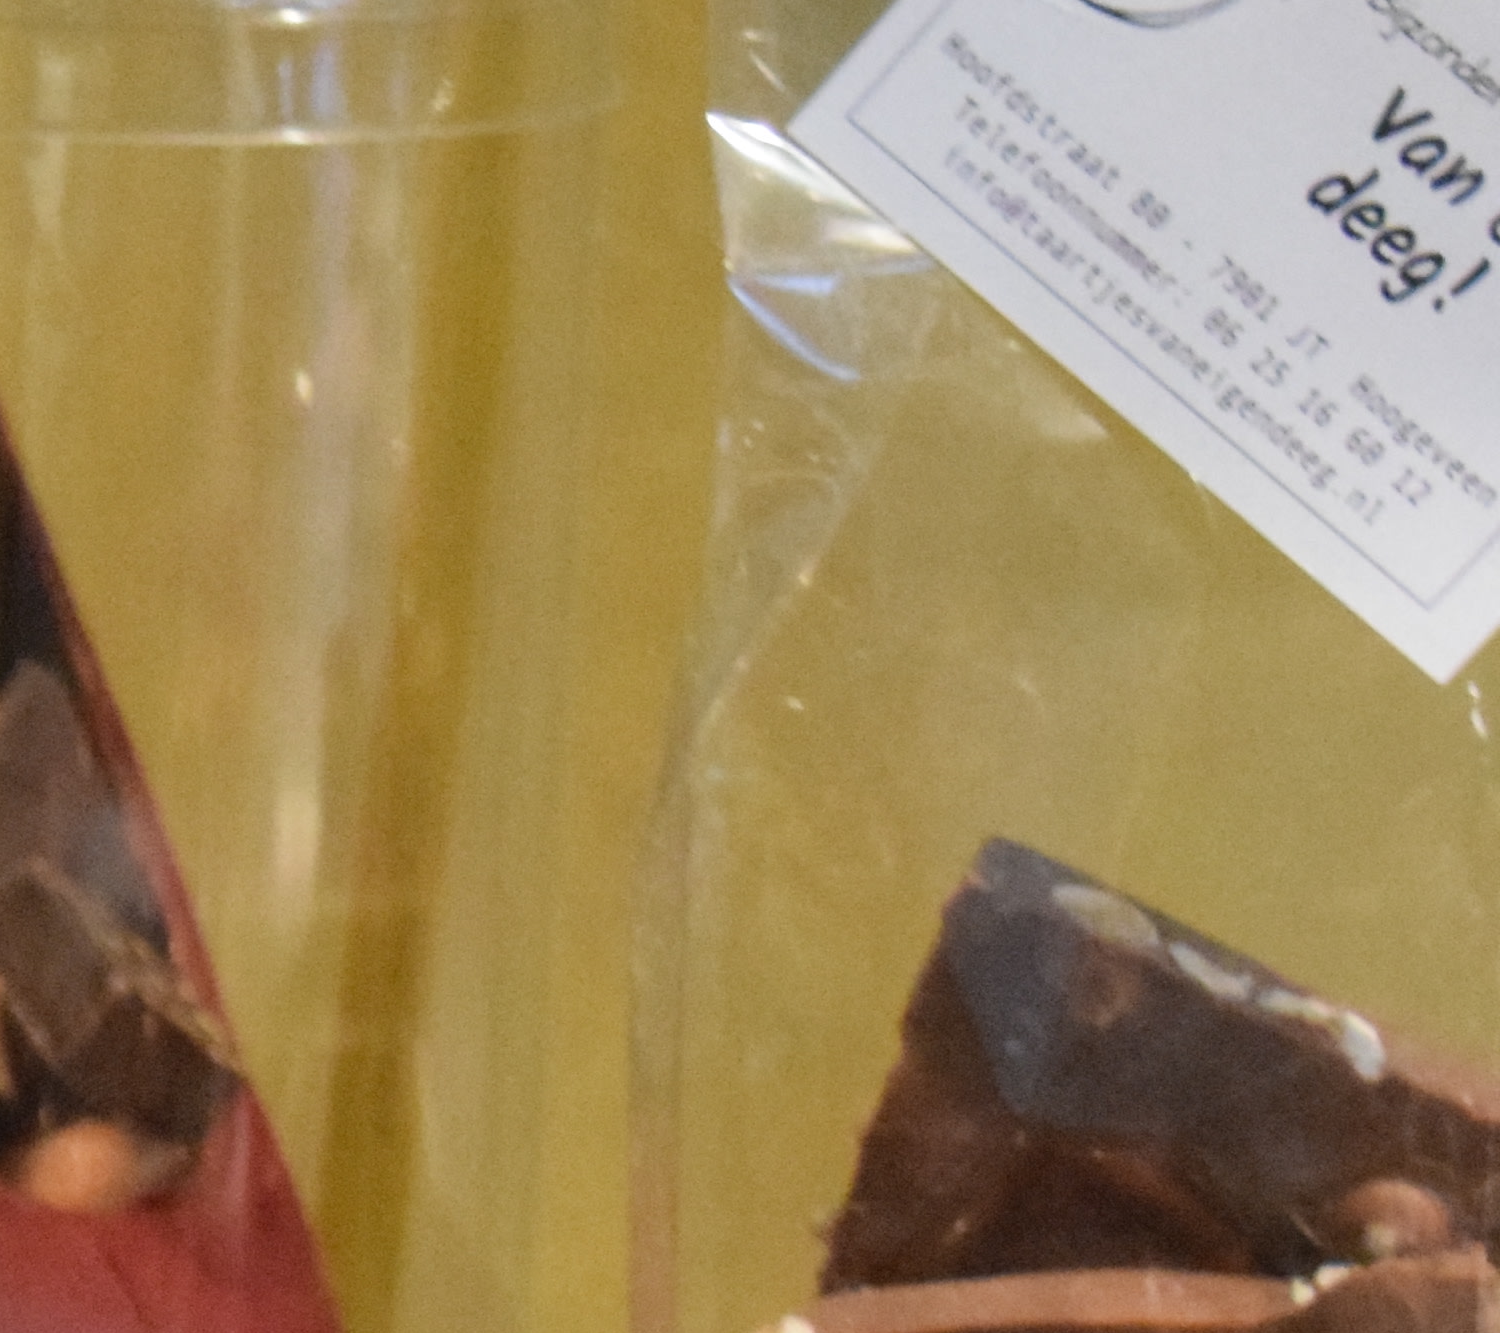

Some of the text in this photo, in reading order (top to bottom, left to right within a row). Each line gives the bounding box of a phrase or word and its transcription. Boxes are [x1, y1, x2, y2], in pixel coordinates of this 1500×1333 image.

[943, 32, 1121, 192] Hoofdstraat
[1350, 373, 1498, 508] Hoogeveen
[956, 94, 1192, 308] Telefoonnummer:
[1250, 346, 1291, 388] 25
[1296, 387, 1339, 428] 16
[1391, 466, 1433, 507] 12
[1306, 168, 1491, 313] deeg!
[1372, 85, 1485, 206] Van
[945, 147, 1385, 526] info@taartjesvaneigendeeg.nl
